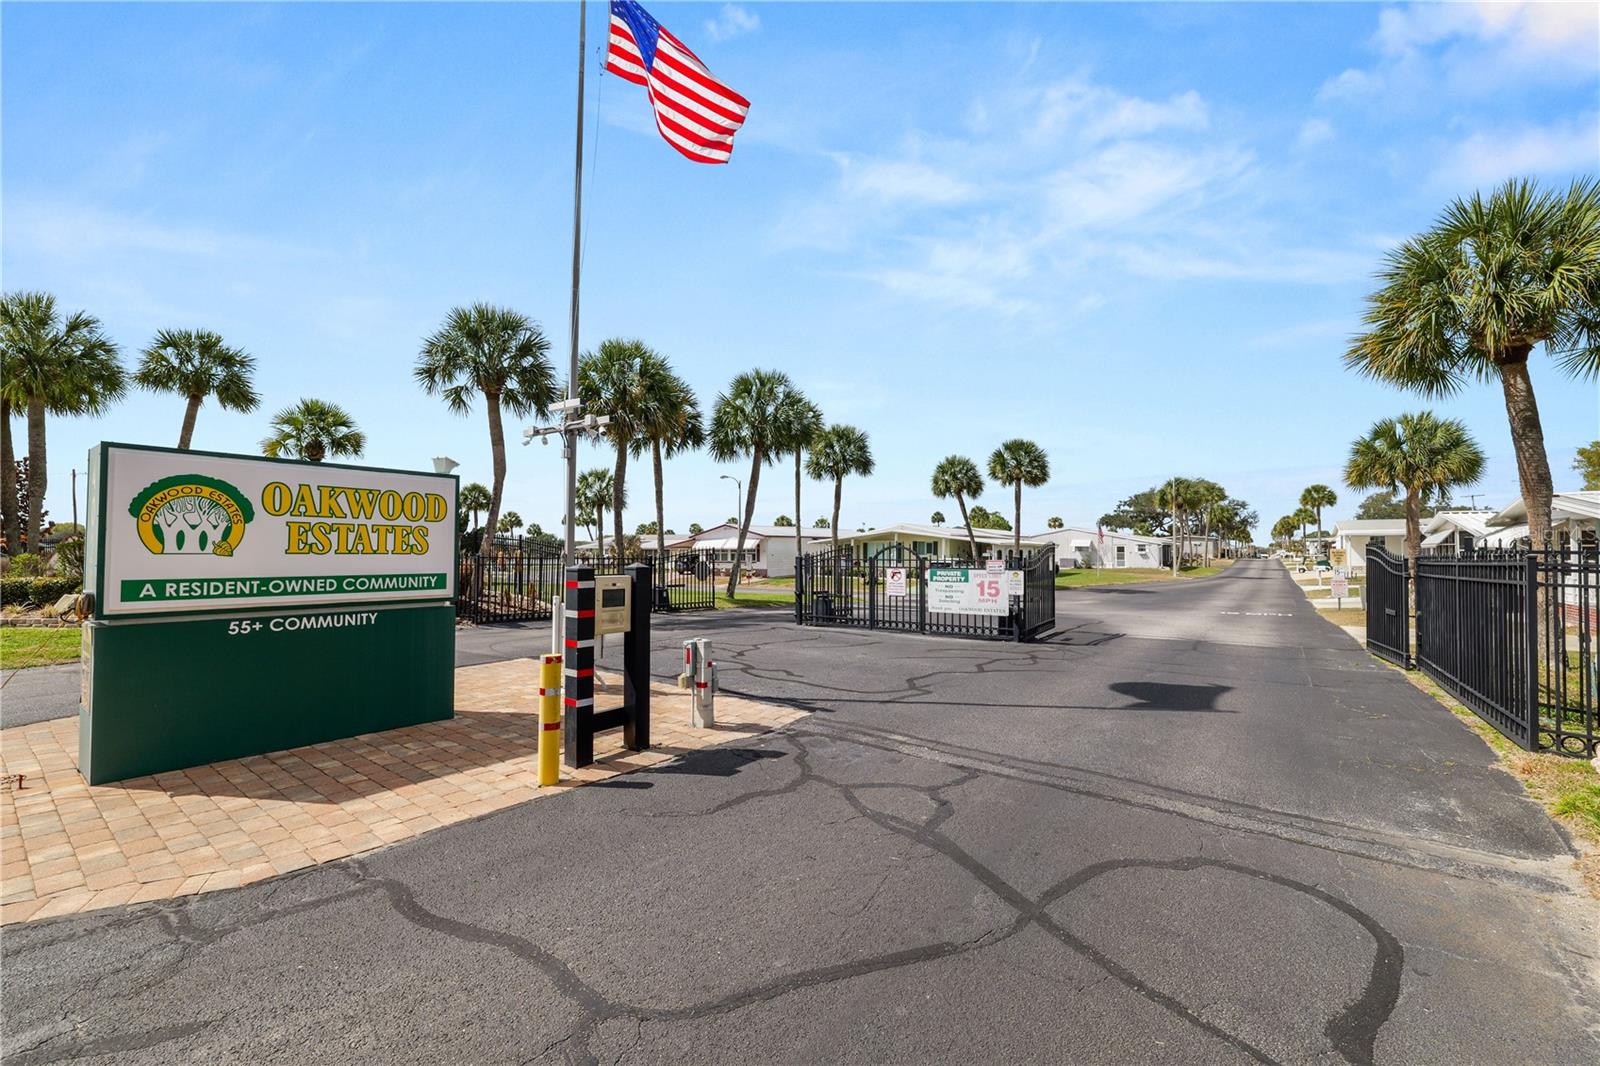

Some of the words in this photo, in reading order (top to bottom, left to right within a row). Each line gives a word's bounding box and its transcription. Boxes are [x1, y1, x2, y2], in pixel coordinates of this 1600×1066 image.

[140, 486, 203, 523] OAKWOOD
[208, 490, 243, 525] ESTATES
[261, 481, 448, 523] OAKWOOD
[285, 522, 429, 555] ESTATES
[139, 583, 157, 598] A
[165, 578, 337, 597] RESIDENT-OWNED
[342, 576, 437, 591] COMMUNITY
[976, 580, 1001, 598] 15
[227, 619, 264, 635] 55+
[269, 613, 378, 632] COMMUNITY
